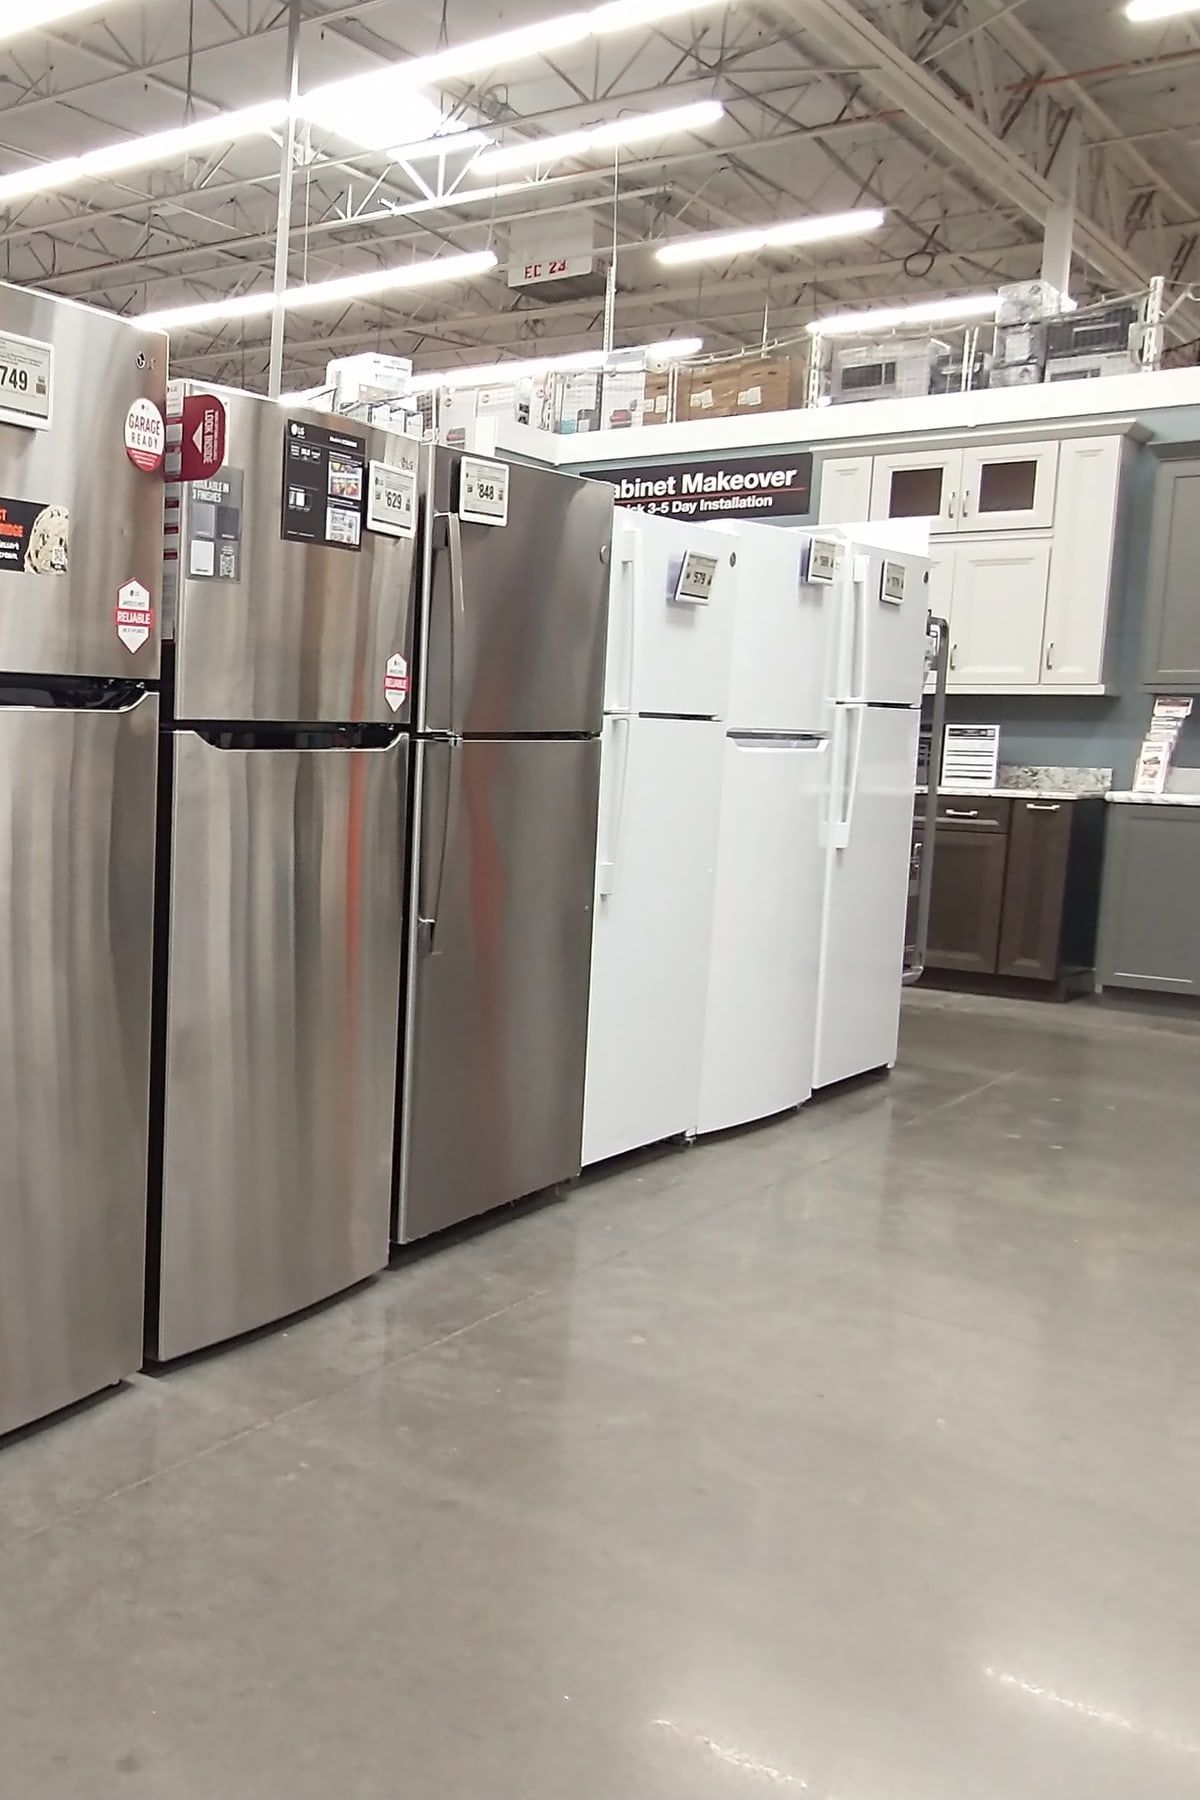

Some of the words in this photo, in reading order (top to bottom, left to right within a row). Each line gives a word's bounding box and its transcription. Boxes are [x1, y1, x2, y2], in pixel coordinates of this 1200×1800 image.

[524, 264, 542, 279] EC
[548, 259, 567, 275] 23
[128, 413, 161, 436] GARAGE
[131, 432, 158, 449] READY
[614, 476, 676, 499] abinet
[681, 468, 798, 494] Makeover
[647, 501, 670, 514] 3-5
[671, 500, 698, 514] Day
[699, 495, 773, 511] Installation
[117, 610, 151, 625] RELIABLE
